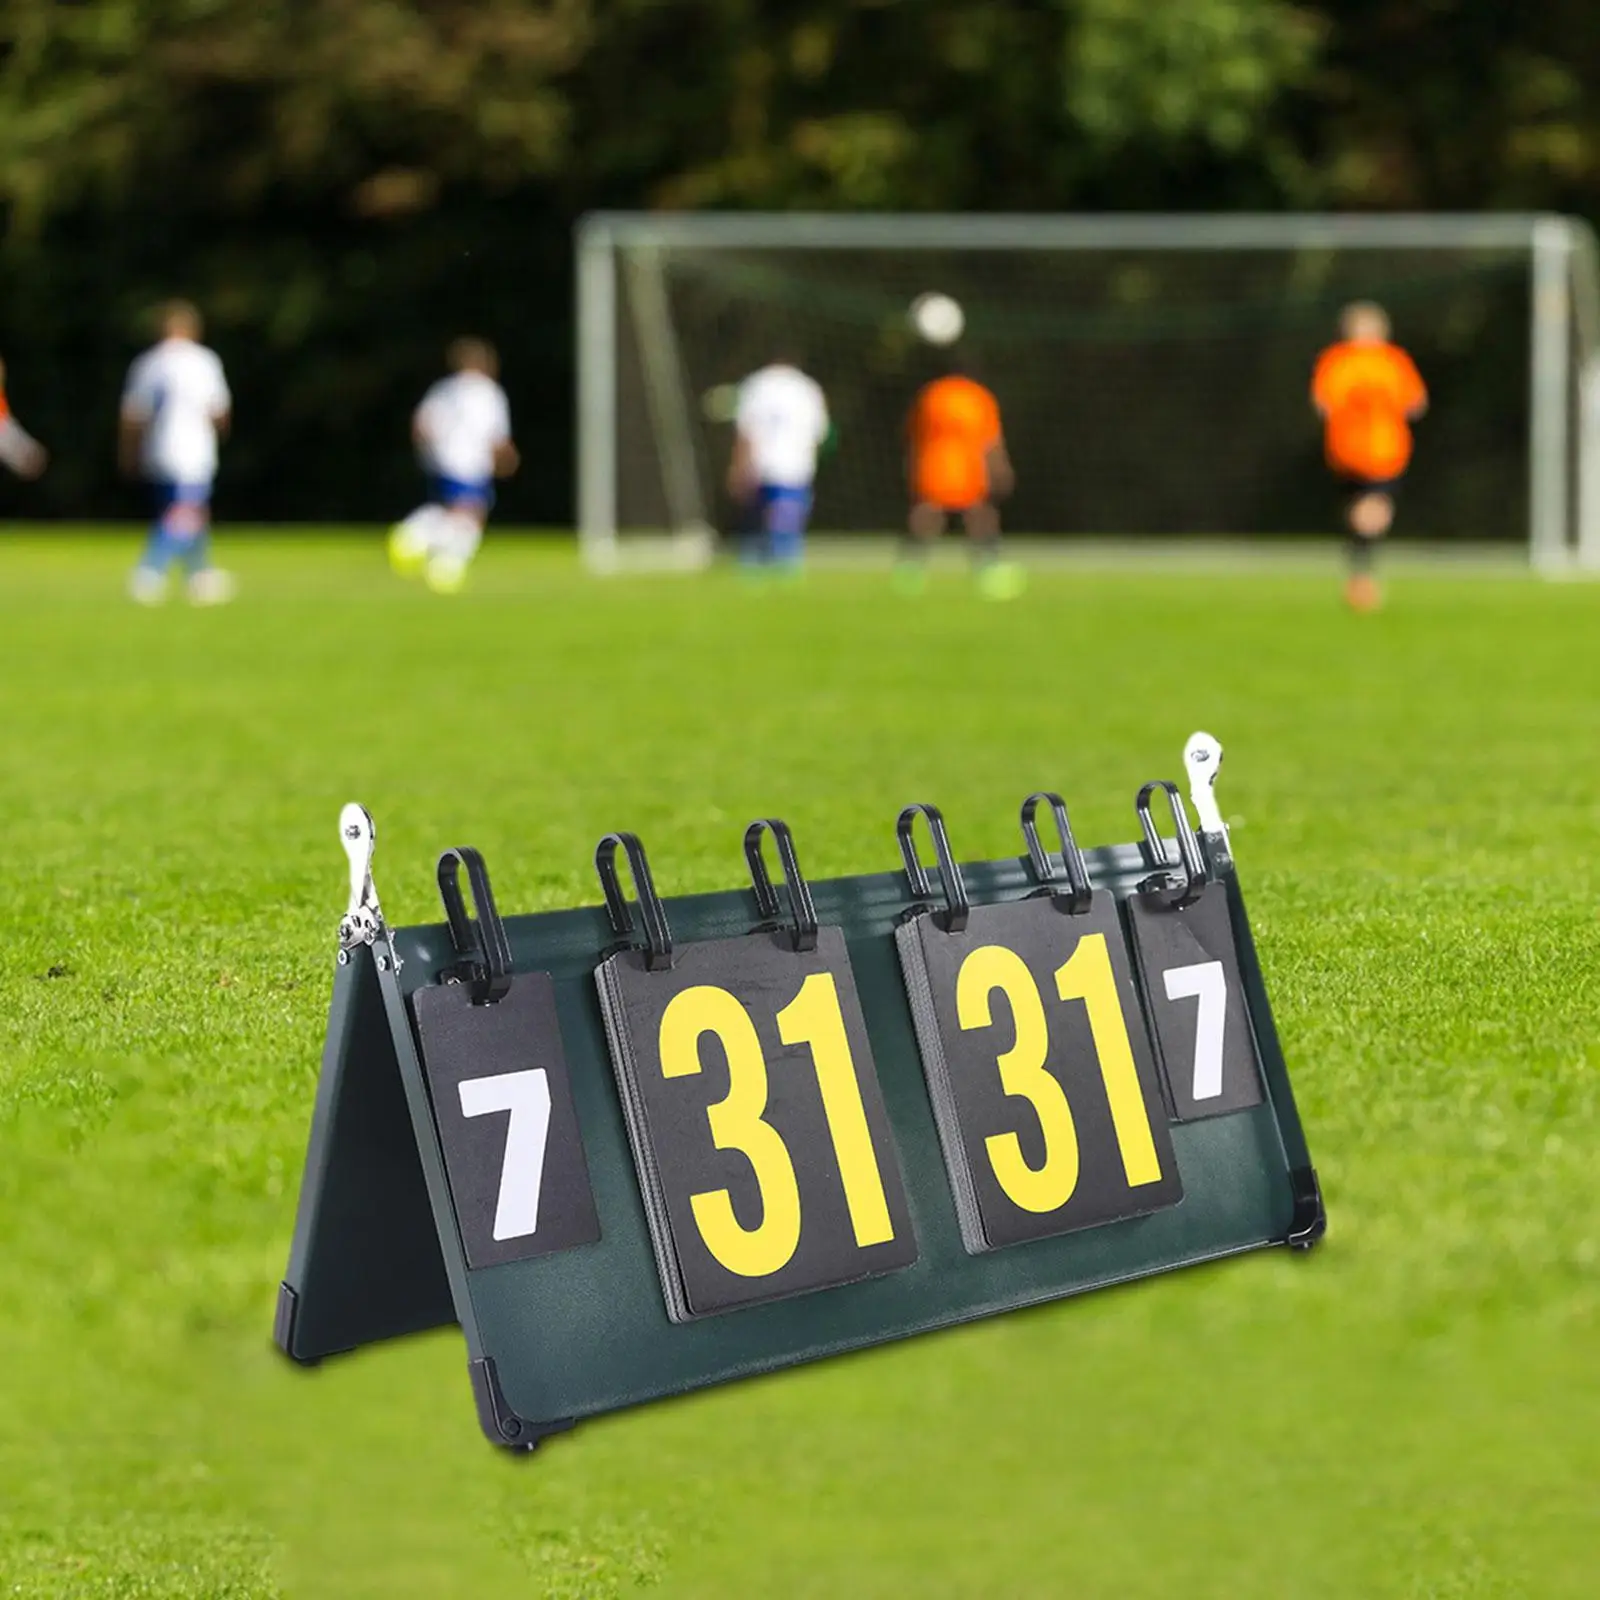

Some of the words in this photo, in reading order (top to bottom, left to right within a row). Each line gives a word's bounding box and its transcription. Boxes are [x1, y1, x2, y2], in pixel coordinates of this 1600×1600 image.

[658, 973, 895, 1278] 31
[956, 933, 1163, 1214] 31
[1162, 960, 1228, 1101] 7
[457, 1067, 552, 1242] 7
